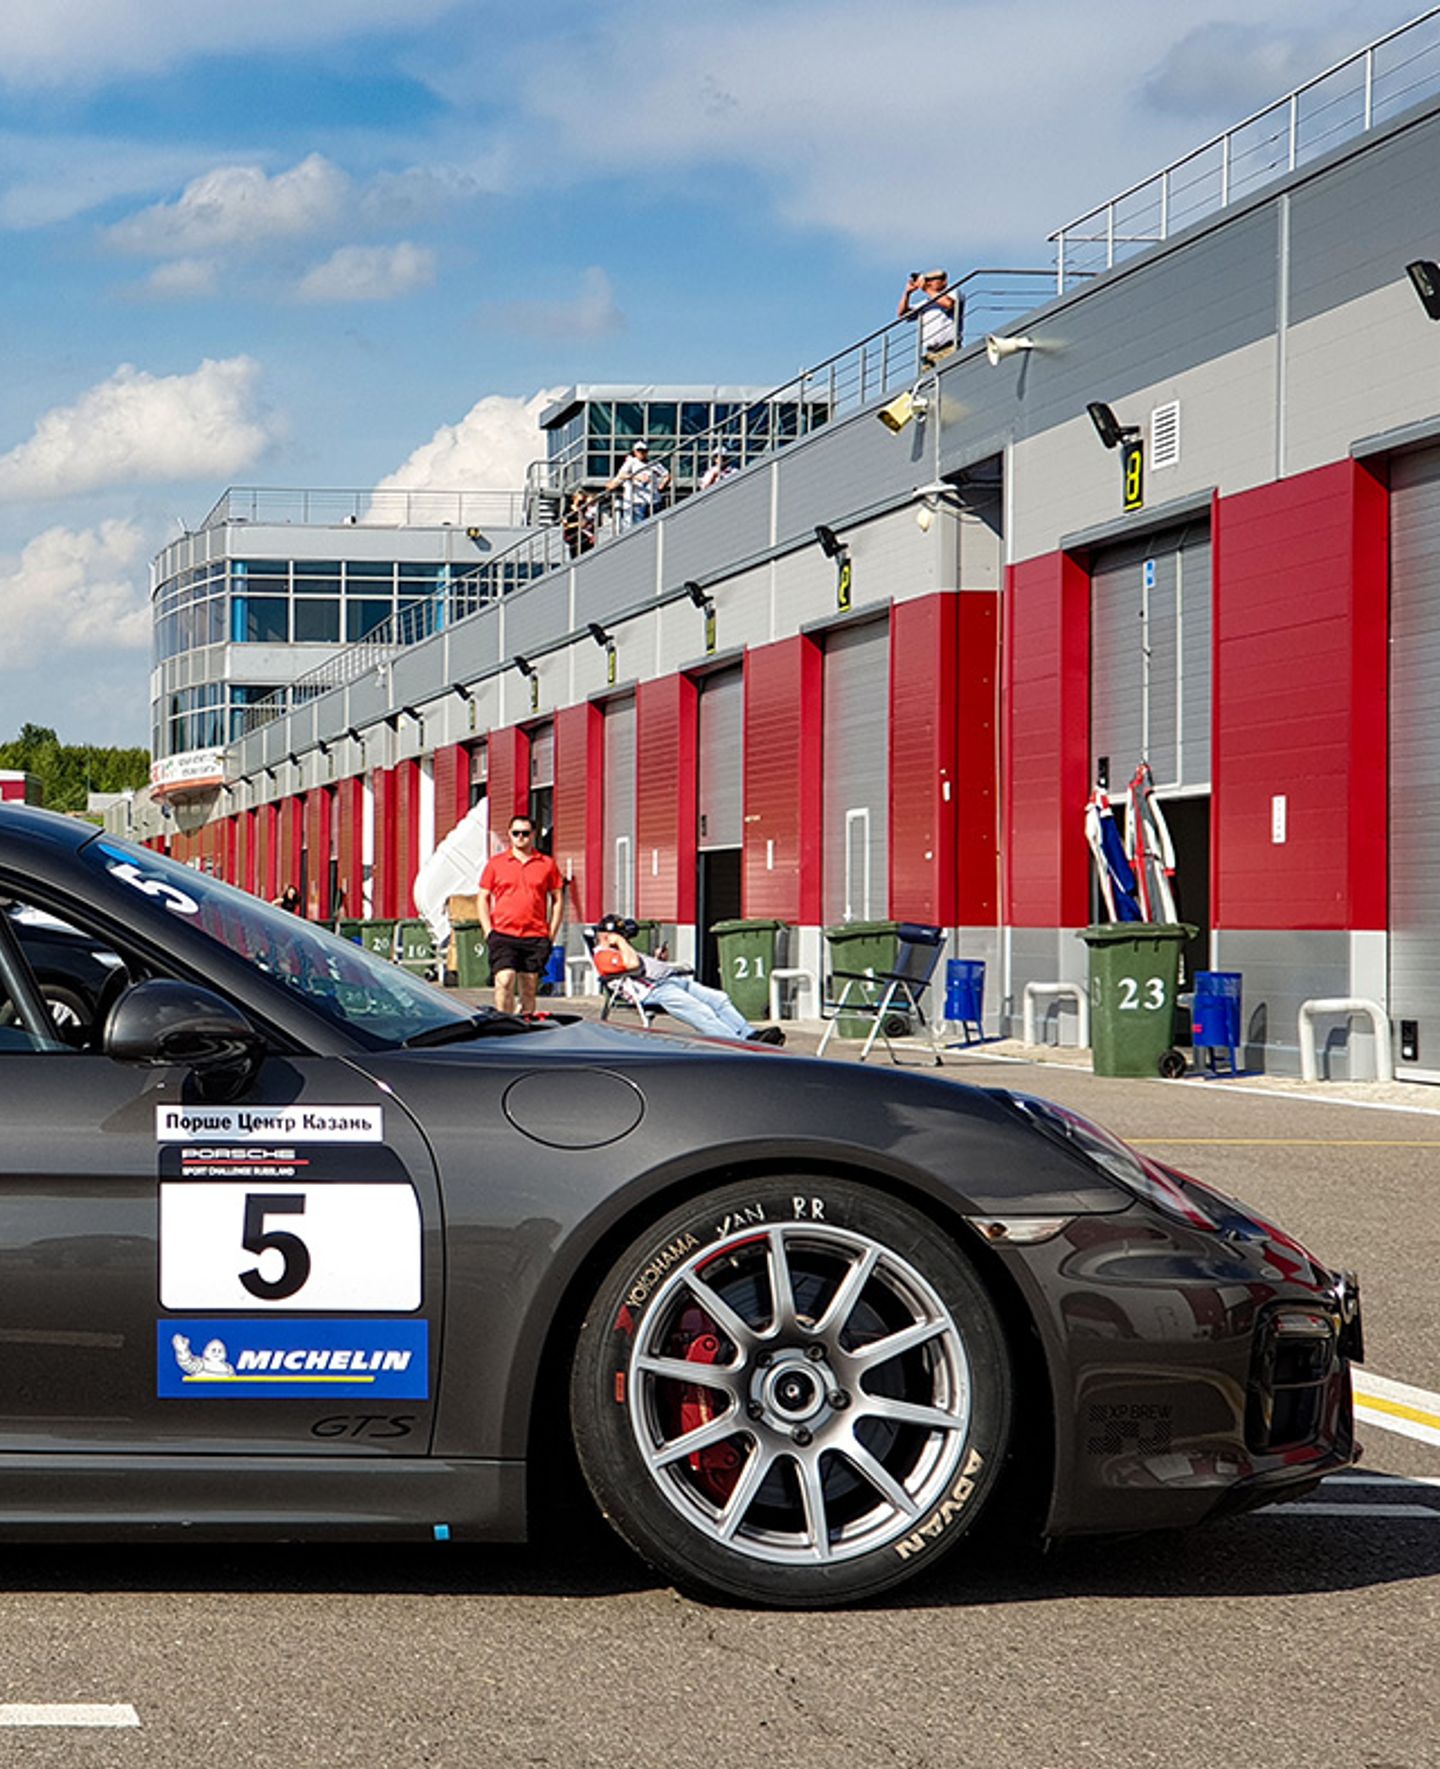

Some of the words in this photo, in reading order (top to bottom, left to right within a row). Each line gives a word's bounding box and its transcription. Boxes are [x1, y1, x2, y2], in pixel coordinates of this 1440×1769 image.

[1126, 449, 1141, 501] 8
[108, 863, 199, 914] 5
[734, 956, 766, 979] 21
[1118, 977, 1165, 1010] 23
[166, 1113, 231, 1131] Порше
[238, 1113, 296, 1132] Центр
[303, 1113, 372, 1130] Казань
[182, 1149, 296, 1159] PORSCHE
[238, 1193, 311, 1300] 5
[626, 1232, 700, 1308] YOKOHAMA
[236, 1350, 412, 1371] MICHELIN
[310, 1415, 416, 1438] GTS
[894, 1447, 985, 1560] ADVAN
